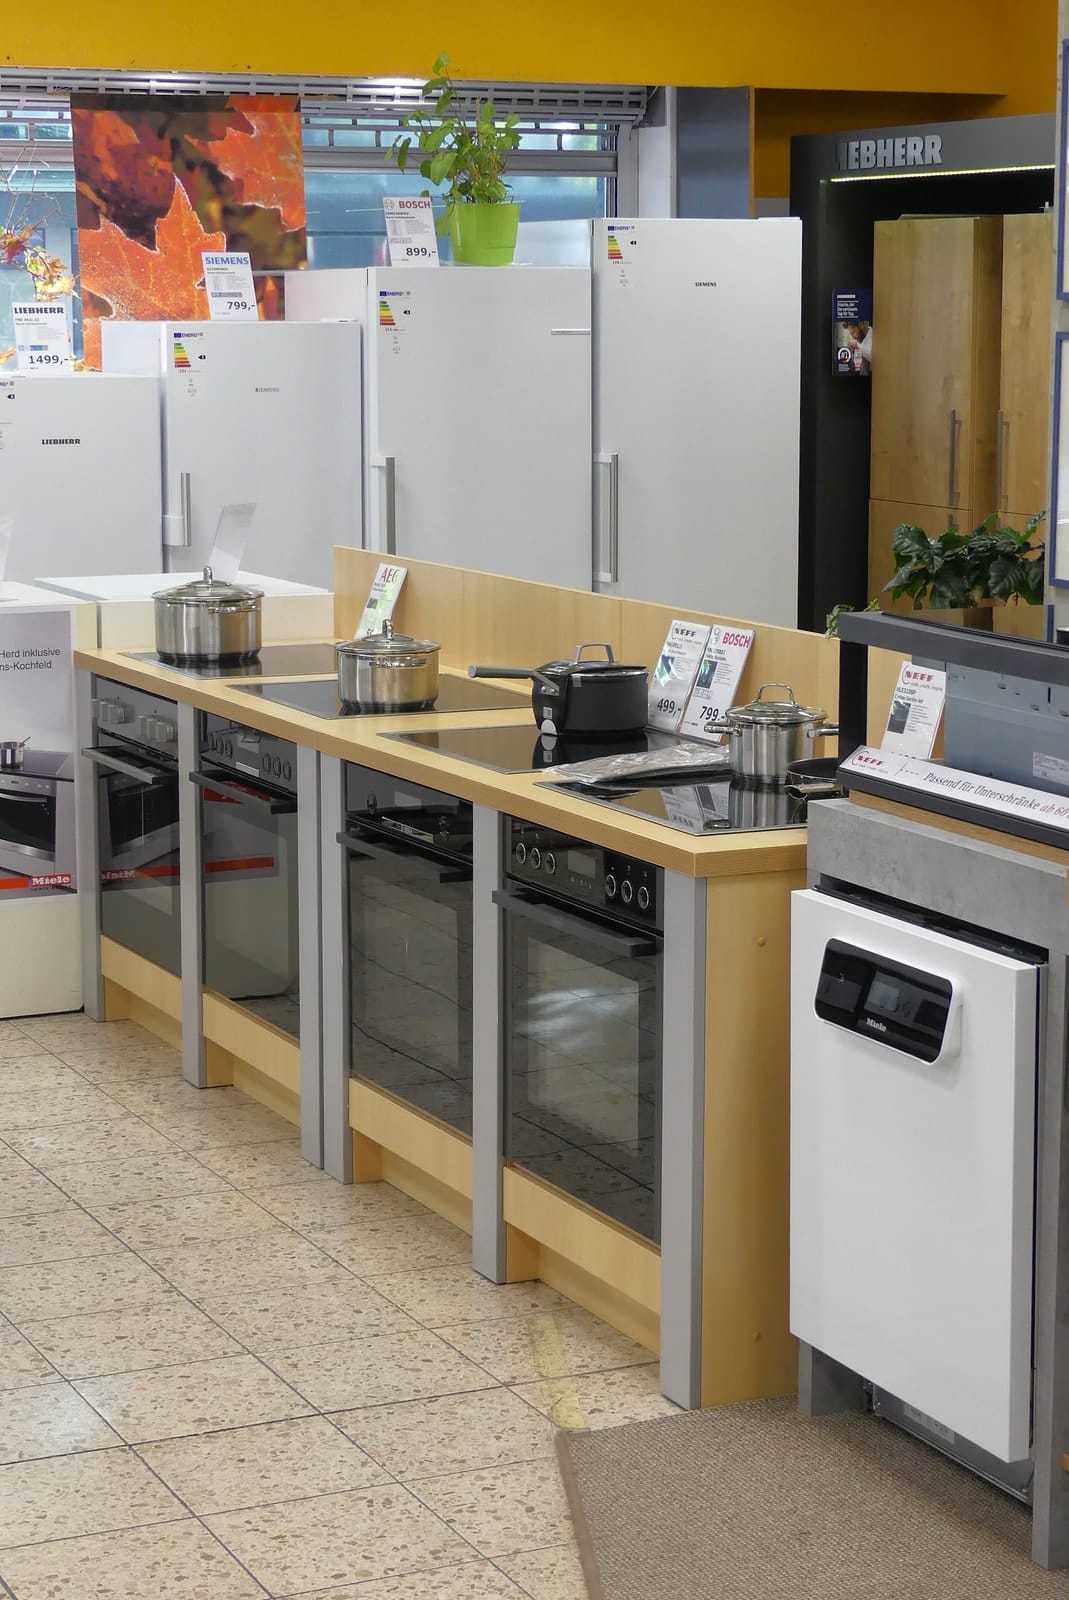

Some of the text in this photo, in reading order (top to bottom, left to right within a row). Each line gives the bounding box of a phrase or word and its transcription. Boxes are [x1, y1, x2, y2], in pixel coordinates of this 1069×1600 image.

[399, 200, 431, 209] BOSCH
[406, 247, 437, 258] 899,-
[205, 256, 249, 265] SIEMENS
[227, 301, 256, 311] 799,-
[28, 354, 69, 366] 1499,-
[722, 632, 751, 648] BOSCH
[22, 647, 61, 657] inklusive
[904, 670, 934, 682] NEFF
[657, 698, 681, 717] 499,-
[923, 772, 962, 789] Passend
[958, 781, 975, 794] für
[975, 785, 1041, 811] Unterschränke
[32, 876, 71, 886] Miele
[865, 1017, 886, 1032] Miele
